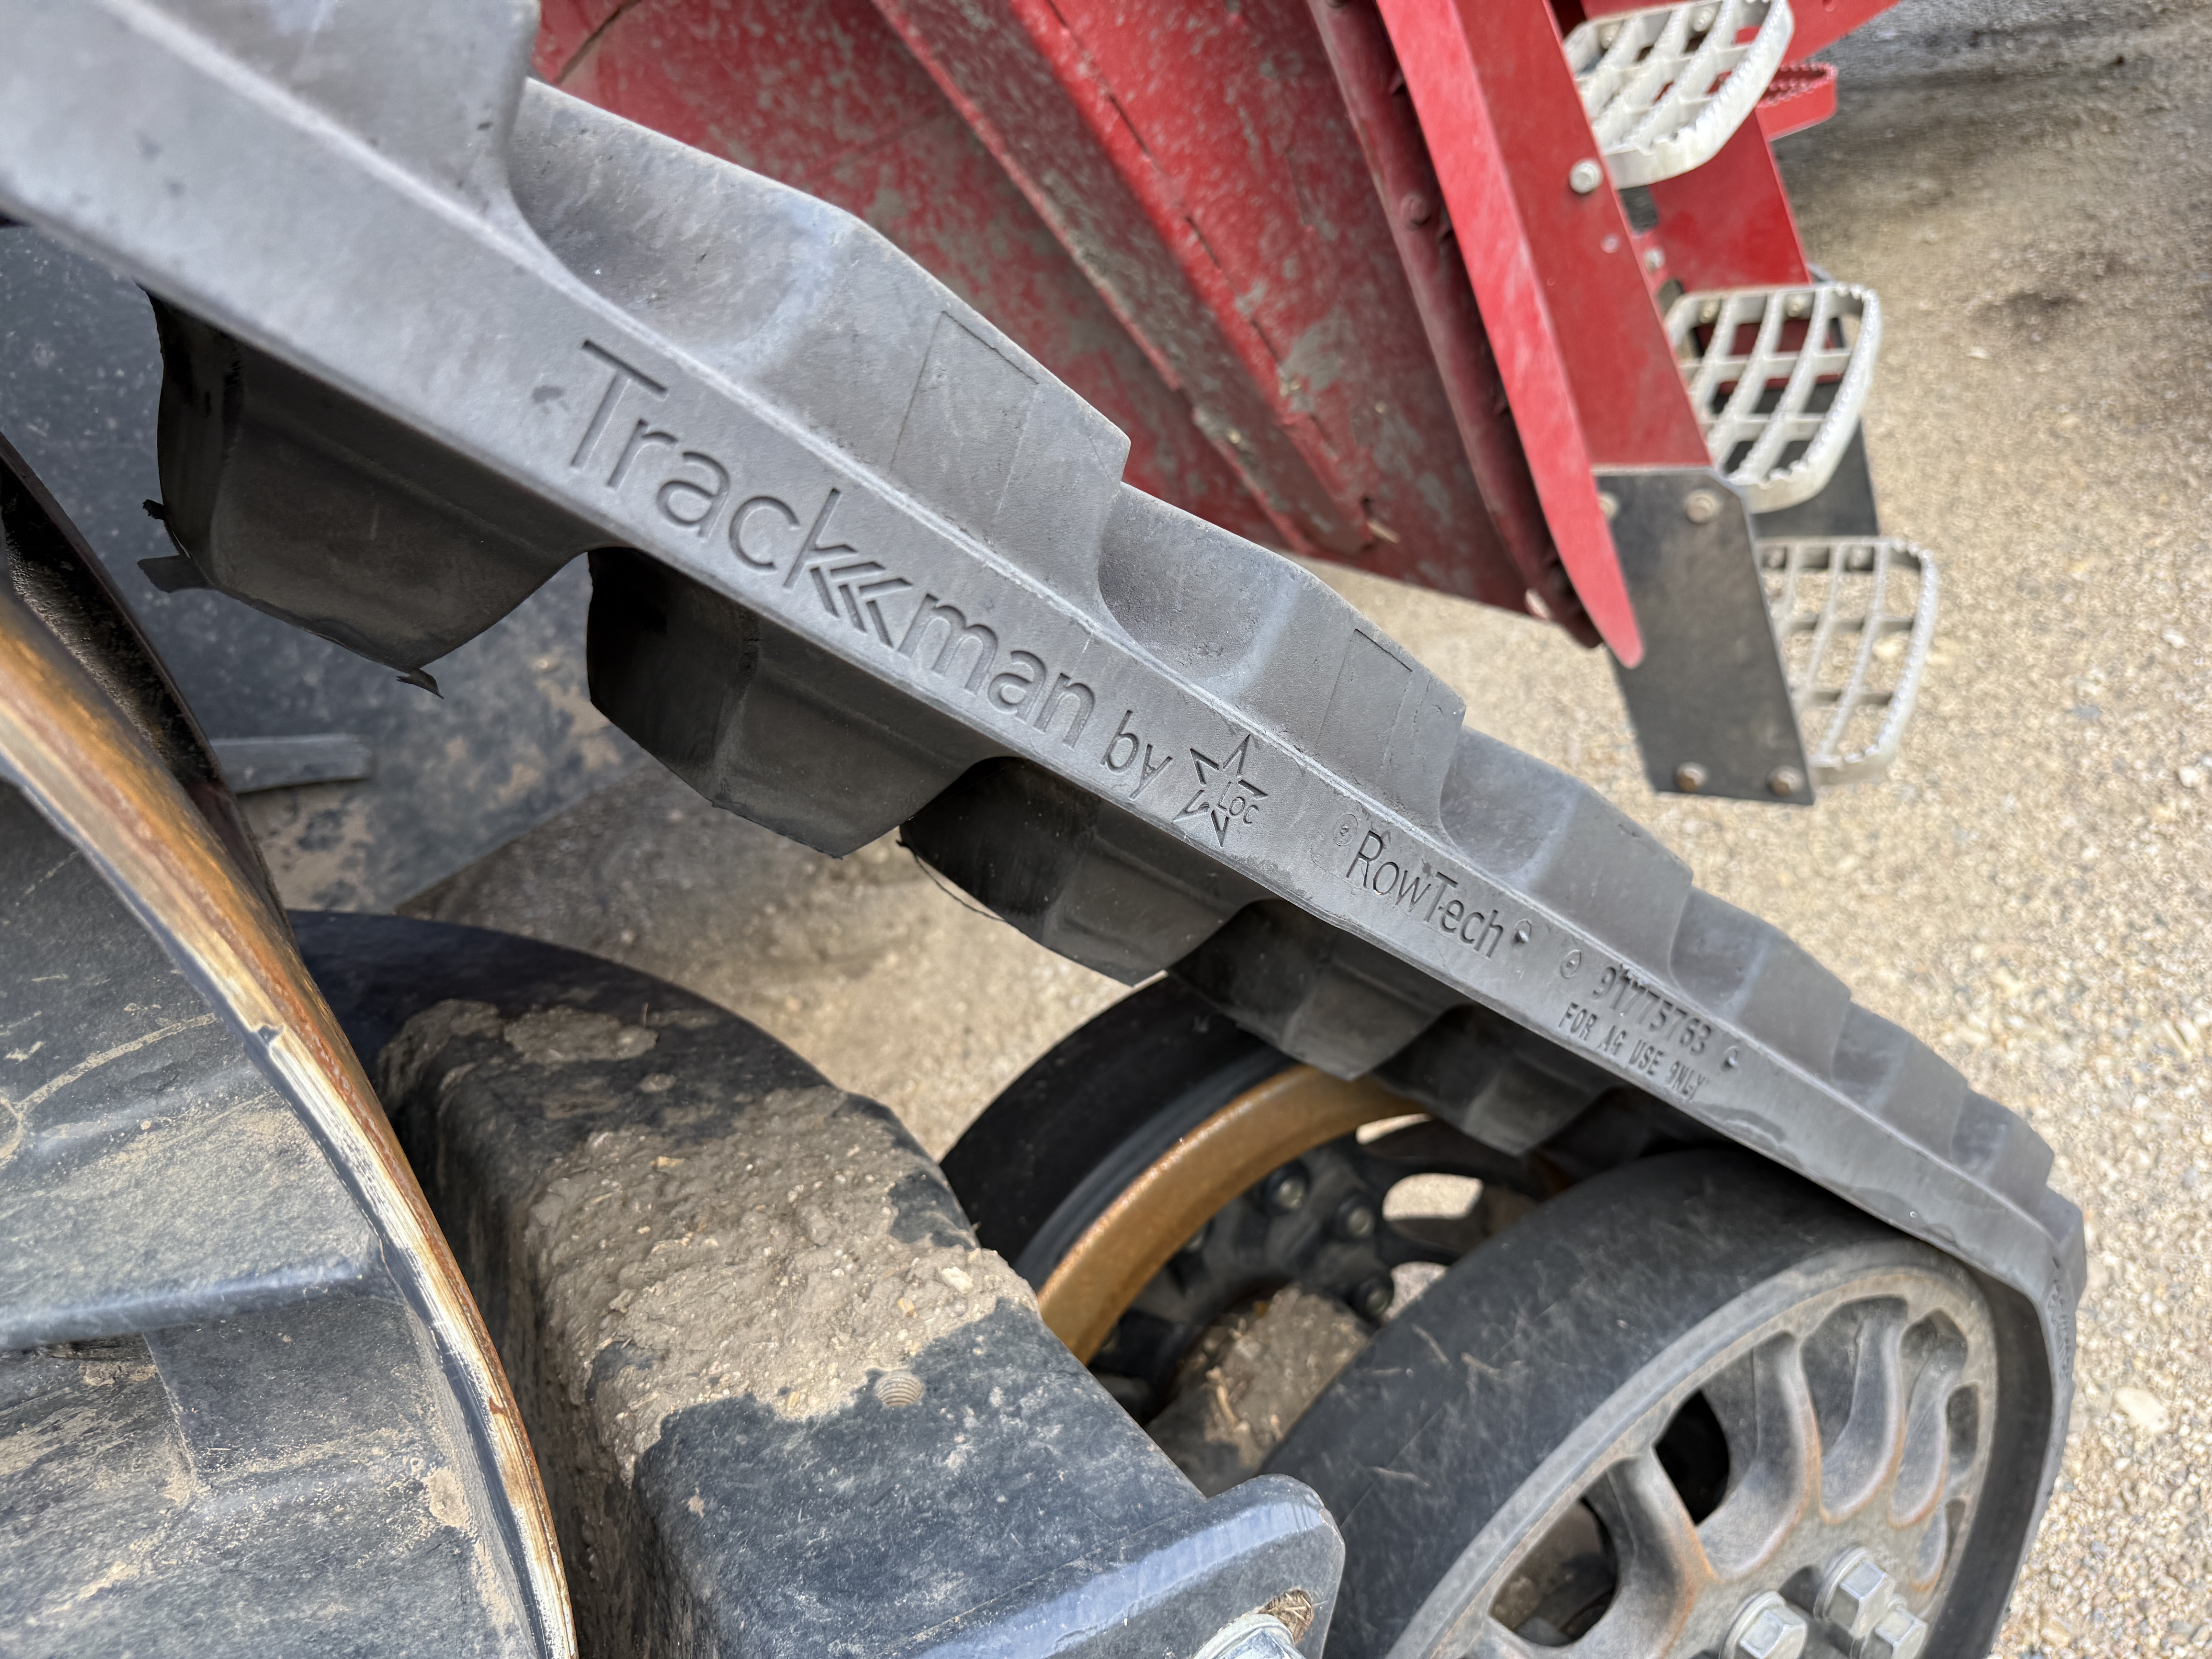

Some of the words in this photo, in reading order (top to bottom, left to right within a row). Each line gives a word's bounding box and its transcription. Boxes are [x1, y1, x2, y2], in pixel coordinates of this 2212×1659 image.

[1100, 709, 1173, 800] by
[1346, 830, 1504, 959] RowTech
[1558, 1002, 1598, 1041] FOR
[1595, 1025, 1627, 1056] AG
[1628, 1039, 1664, 1076] USE
